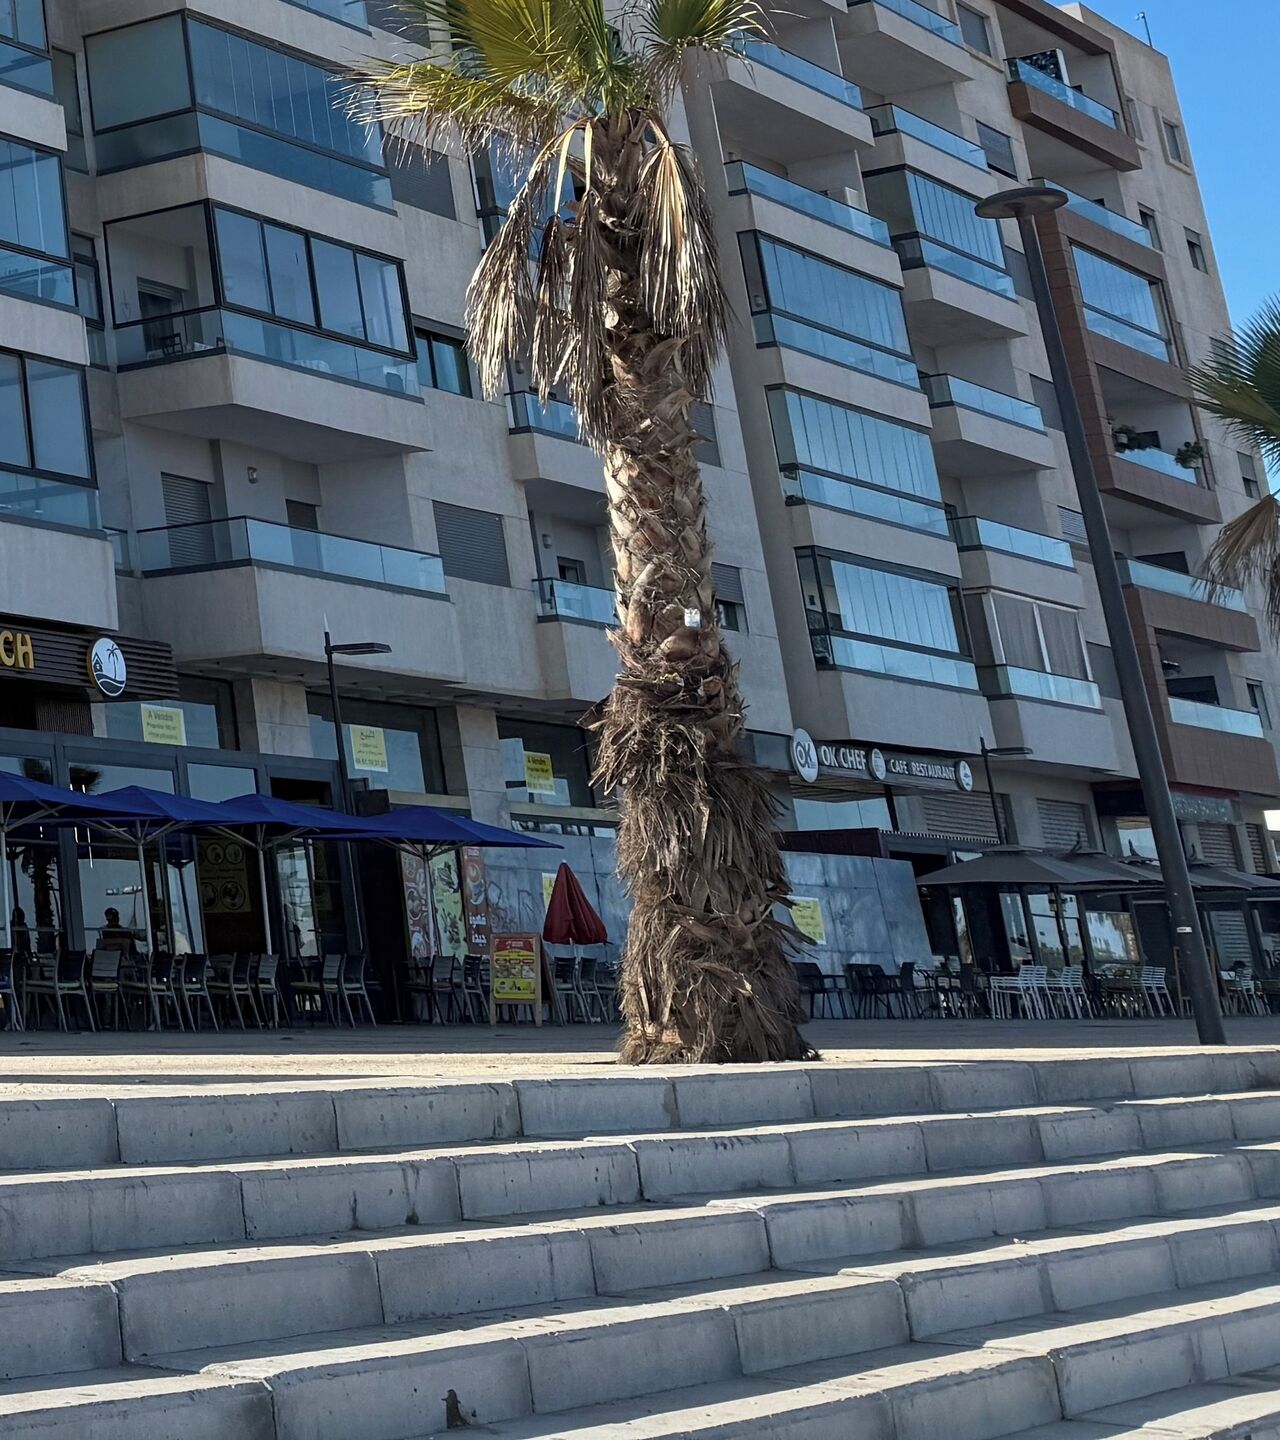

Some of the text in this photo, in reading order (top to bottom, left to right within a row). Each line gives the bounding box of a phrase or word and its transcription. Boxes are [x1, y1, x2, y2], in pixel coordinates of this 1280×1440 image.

[821, 745, 839, 767] OK
[840, 747, 867, 770] CHEF
[890, 759, 909, 774] CAFE
[911, 762, 957, 780] RESTAURANT
